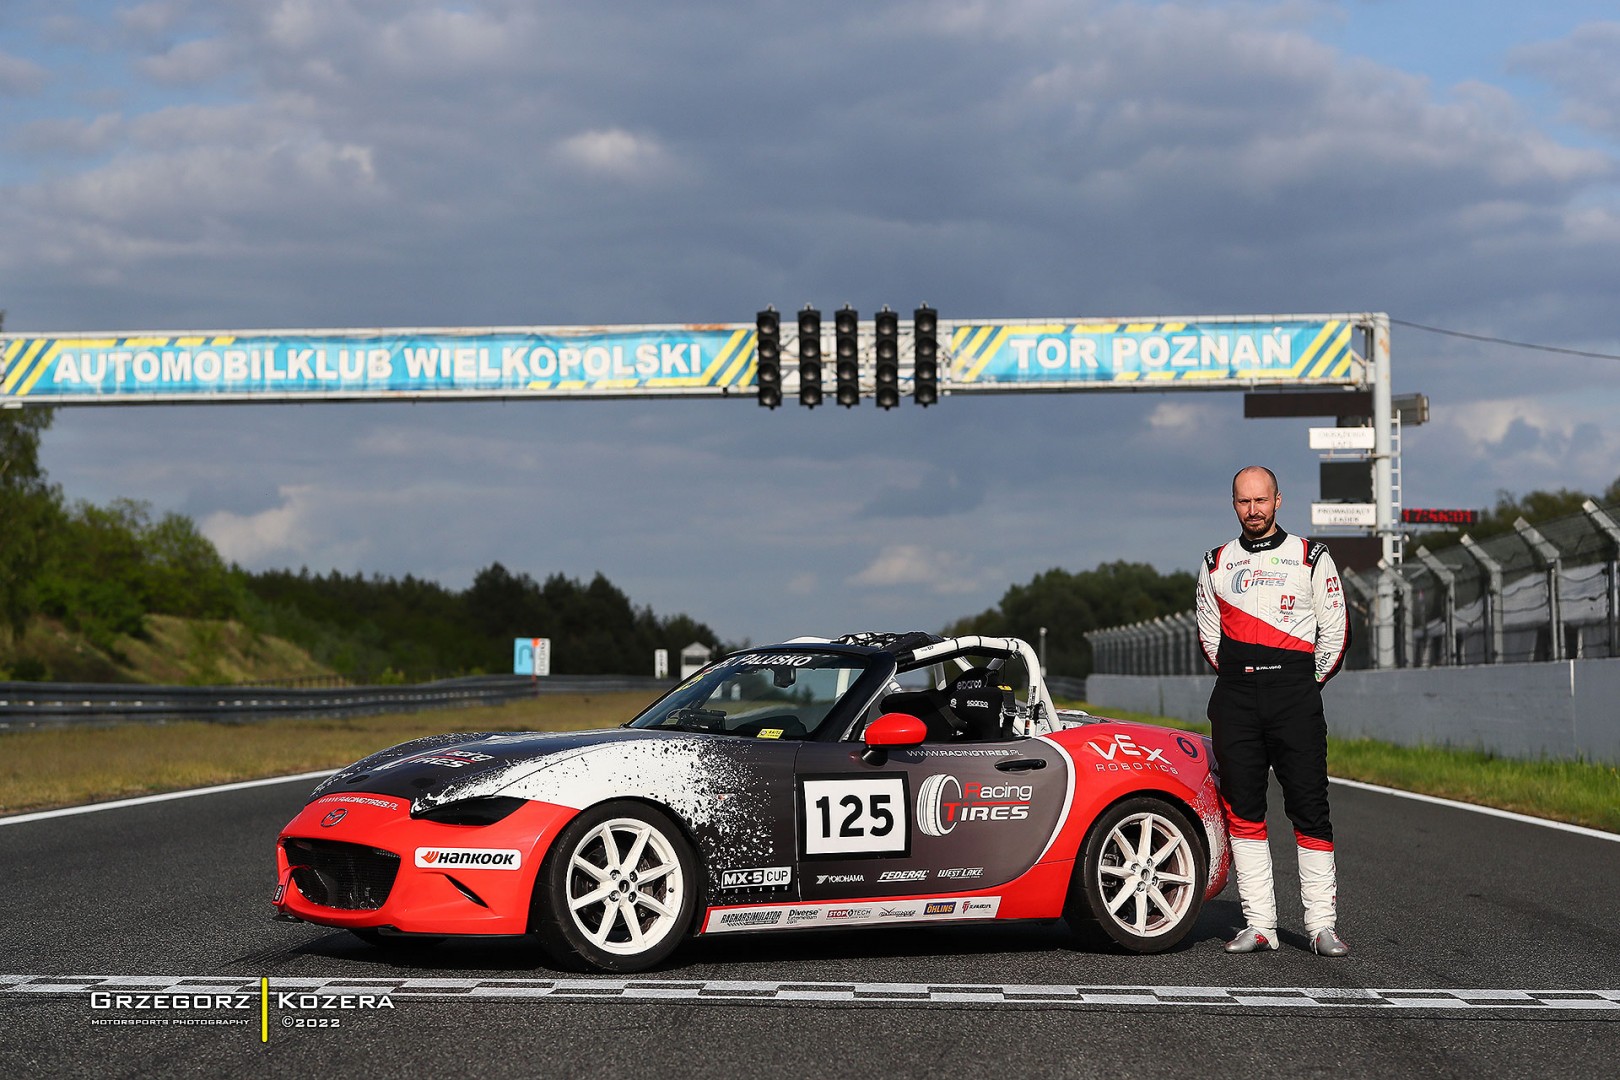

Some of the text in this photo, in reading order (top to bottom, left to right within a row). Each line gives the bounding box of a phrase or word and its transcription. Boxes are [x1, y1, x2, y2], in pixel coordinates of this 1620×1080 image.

[1009, 327, 1292, 369] TOR POZNAŃ
[53, 343, 702, 384] AUTOMOBILKLUB WIELKOPOLSKI
[1088, 734, 1172, 765] VEX
[1096, 763, 1179, 775] ROBOTICS
[964, 781, 1033, 801] Racing
[815, 794, 894, 839] 125
[438, 851, 516, 865] HANKOOK
[723, 871, 788, 886] MX-5 CUP
[828, 874, 865, 883] YOKOHAMA
[879, 870, 929, 880] FEDERAL
